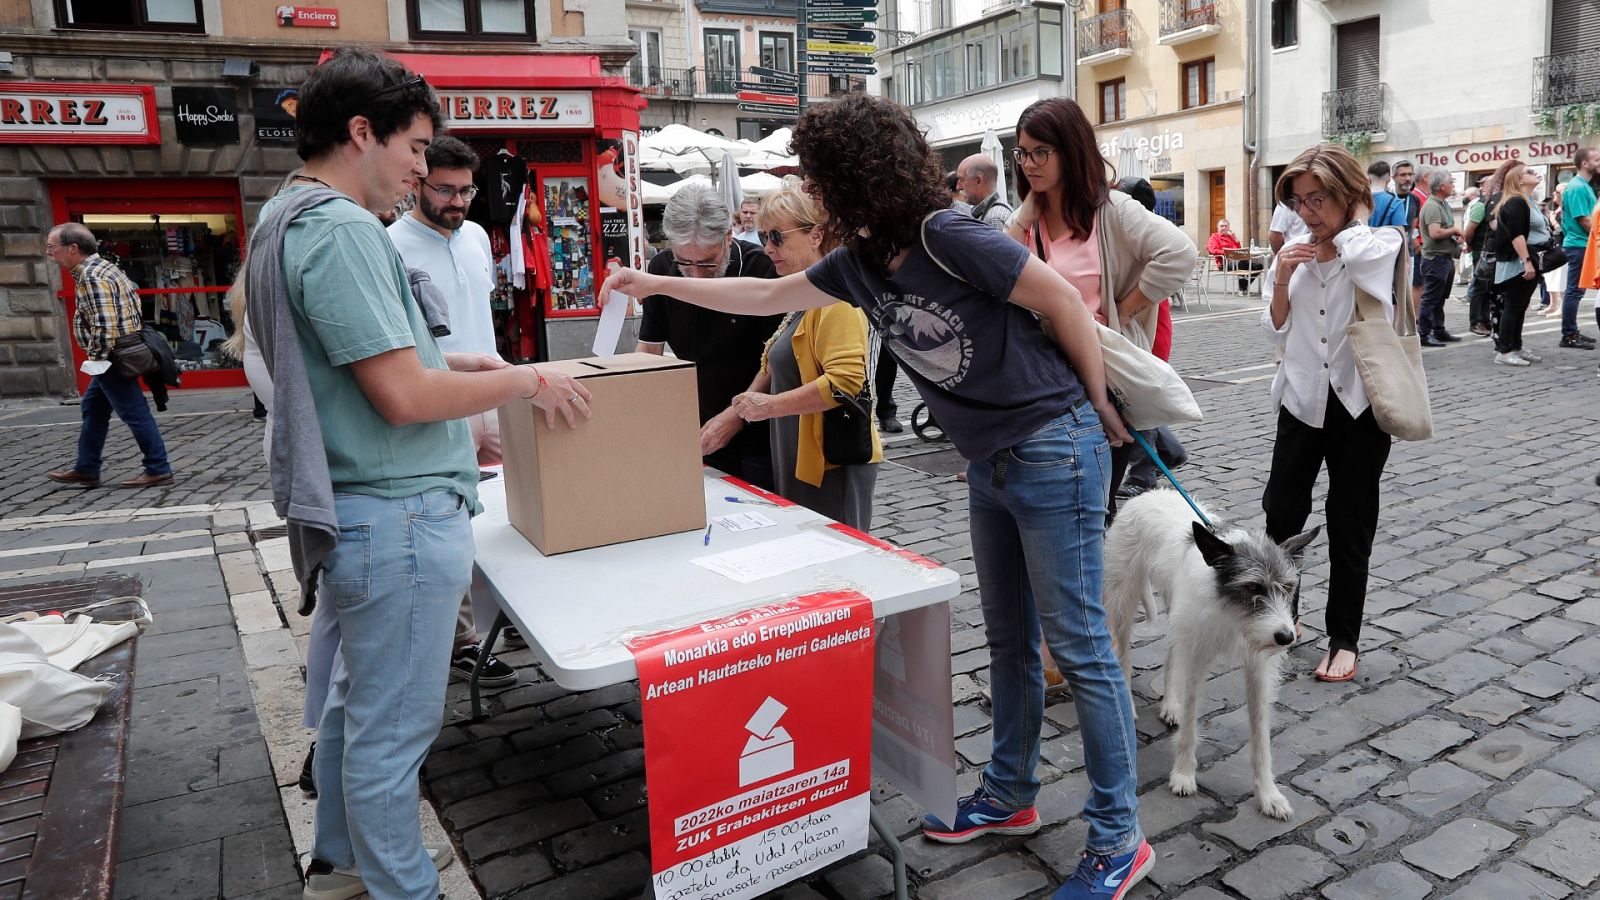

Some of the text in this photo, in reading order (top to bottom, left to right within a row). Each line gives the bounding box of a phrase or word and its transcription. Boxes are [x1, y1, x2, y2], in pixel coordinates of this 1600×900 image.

[298, 11, 336, 21] Encierro
[178, 104, 235, 125] Happy Socks
[1096, 129, 1184, 158] afegia
[1416, 142, 1579, 166] The Cookie Shop
[626, 139, 642, 227] DESDE
[603, 223, 627, 233] ZZZ
[926, 302, 965, 333] BEACH
[664, 607, 851, 667] Monarkia edo Errepublikaren
[646, 625, 871, 701] Artean Hautatzeko Herri Galdeketa
[676, 780, 849, 852] ZUK Erabakitzen duzu!
[680, 766, 846, 832] 2022ko maiatzaren 14a
[726, 860, 750, 880] eta
[755, 842, 785, 866] Udal
